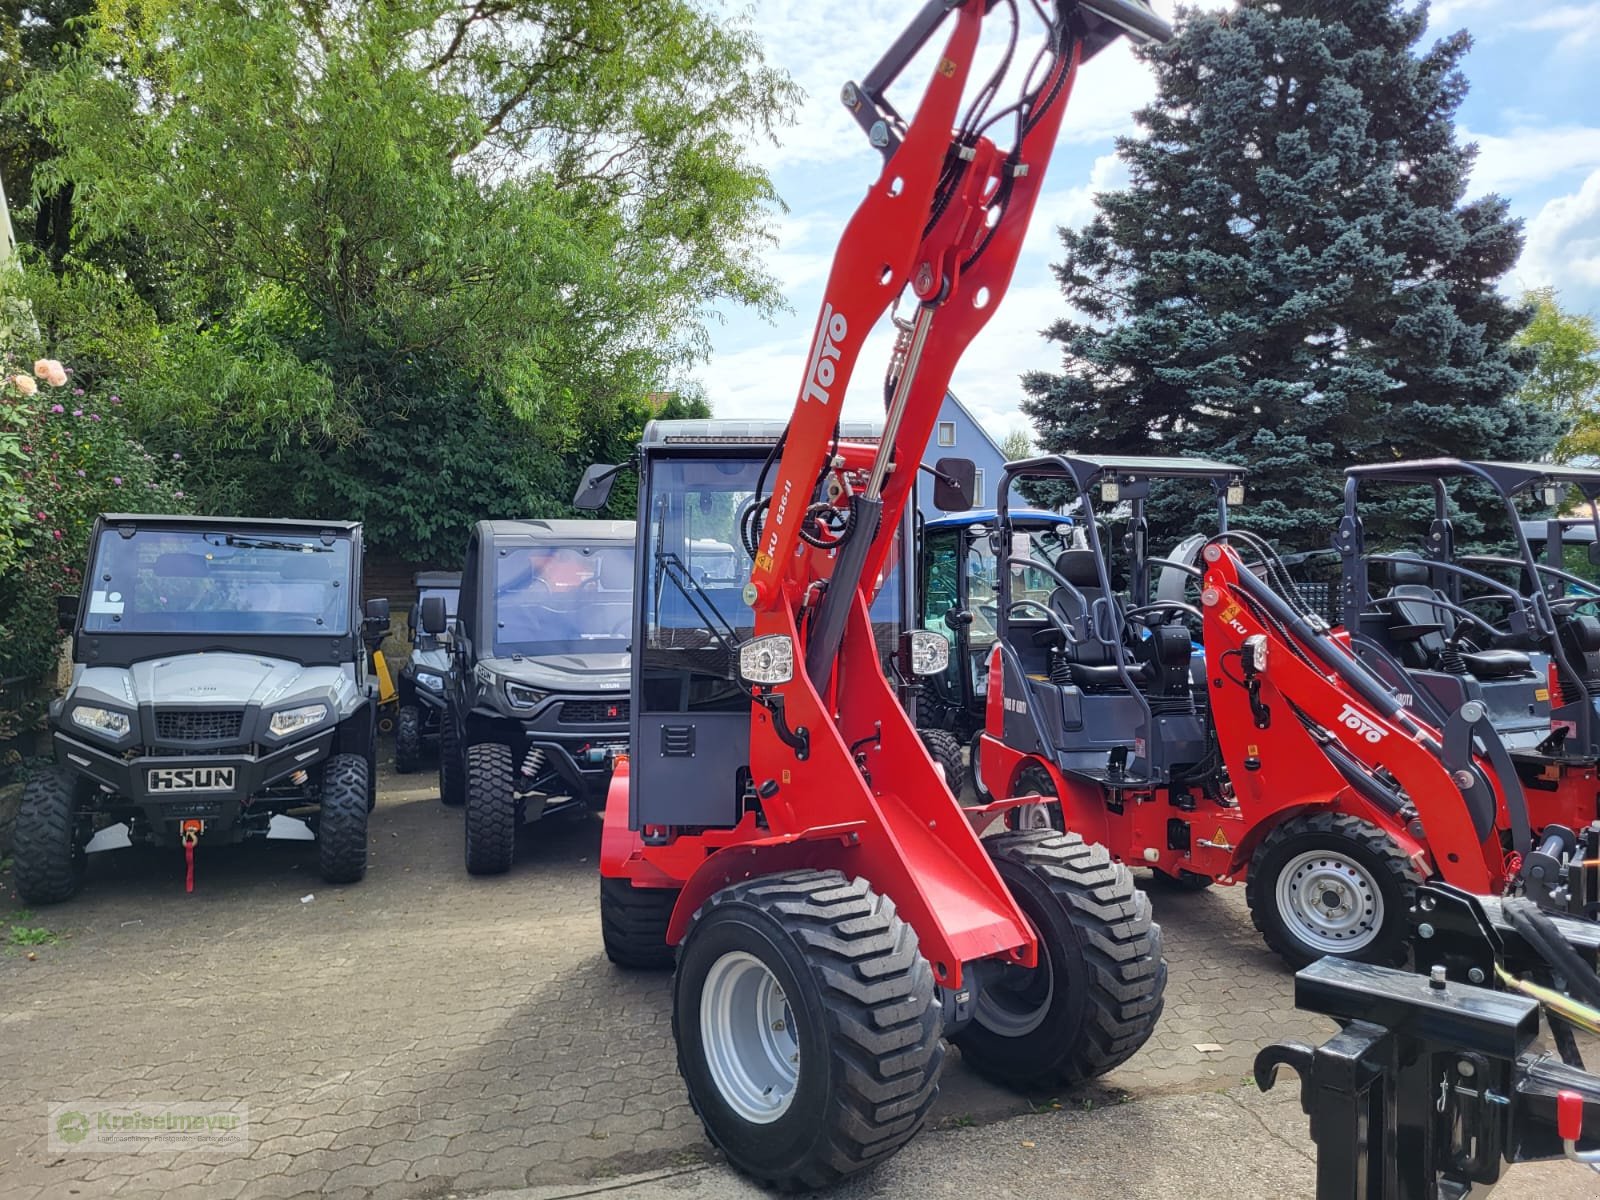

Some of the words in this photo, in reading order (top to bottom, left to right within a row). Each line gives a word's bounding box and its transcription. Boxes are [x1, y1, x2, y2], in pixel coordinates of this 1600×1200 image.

[802, 302, 847, 405] TOYO
[767, 531, 778, 558] KU
[1229, 618, 1248, 635] KU
[1337, 703, 1389, 743] TOYO
